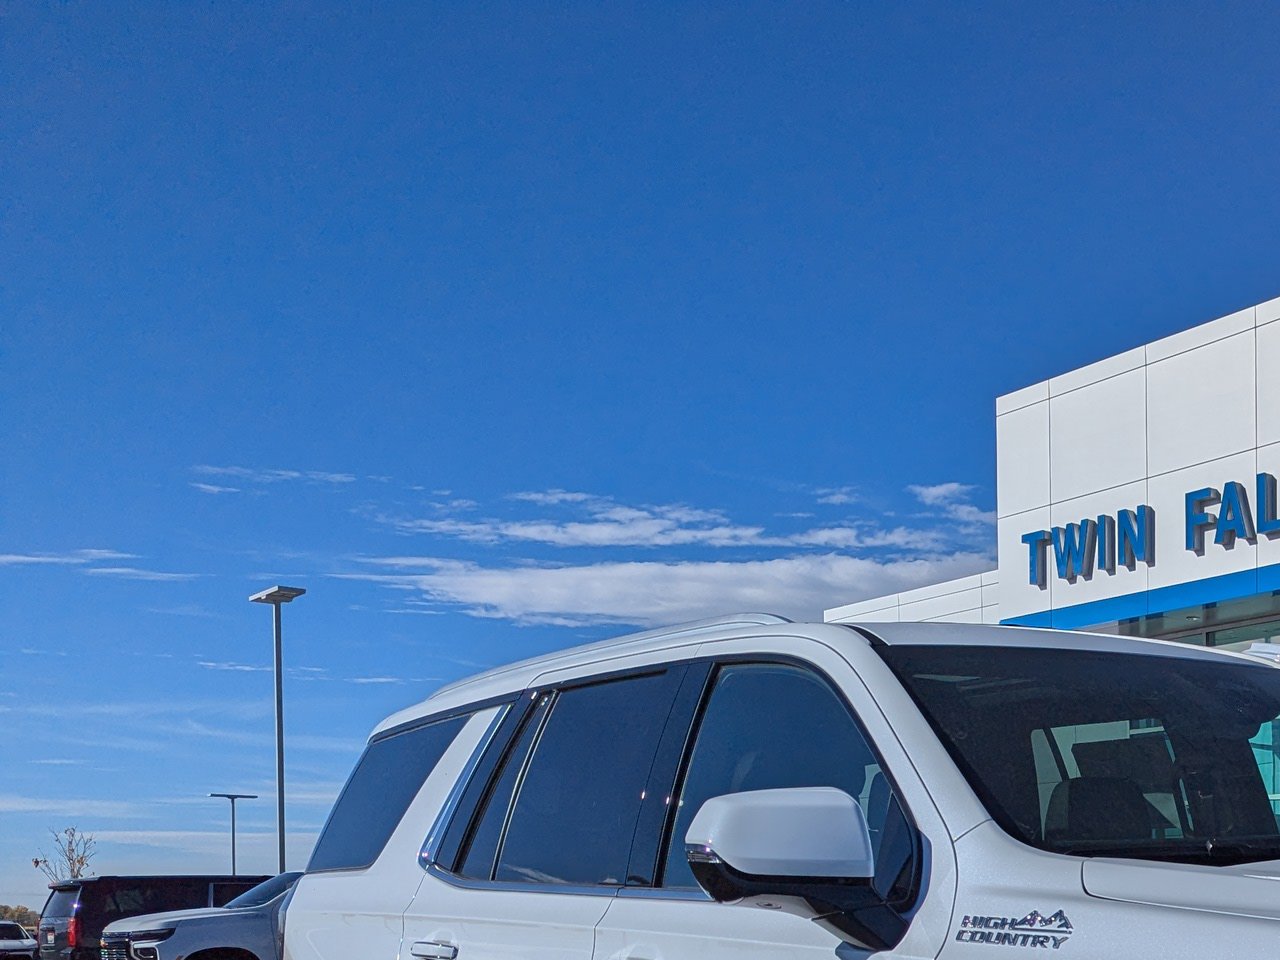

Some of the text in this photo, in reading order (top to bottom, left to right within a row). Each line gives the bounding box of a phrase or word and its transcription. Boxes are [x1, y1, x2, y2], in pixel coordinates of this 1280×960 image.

[1021, 505, 1155, 590] TWIN
[961, 915, 1017, 930] HIGH
[956, 930, 1069, 949] COUNTRY
